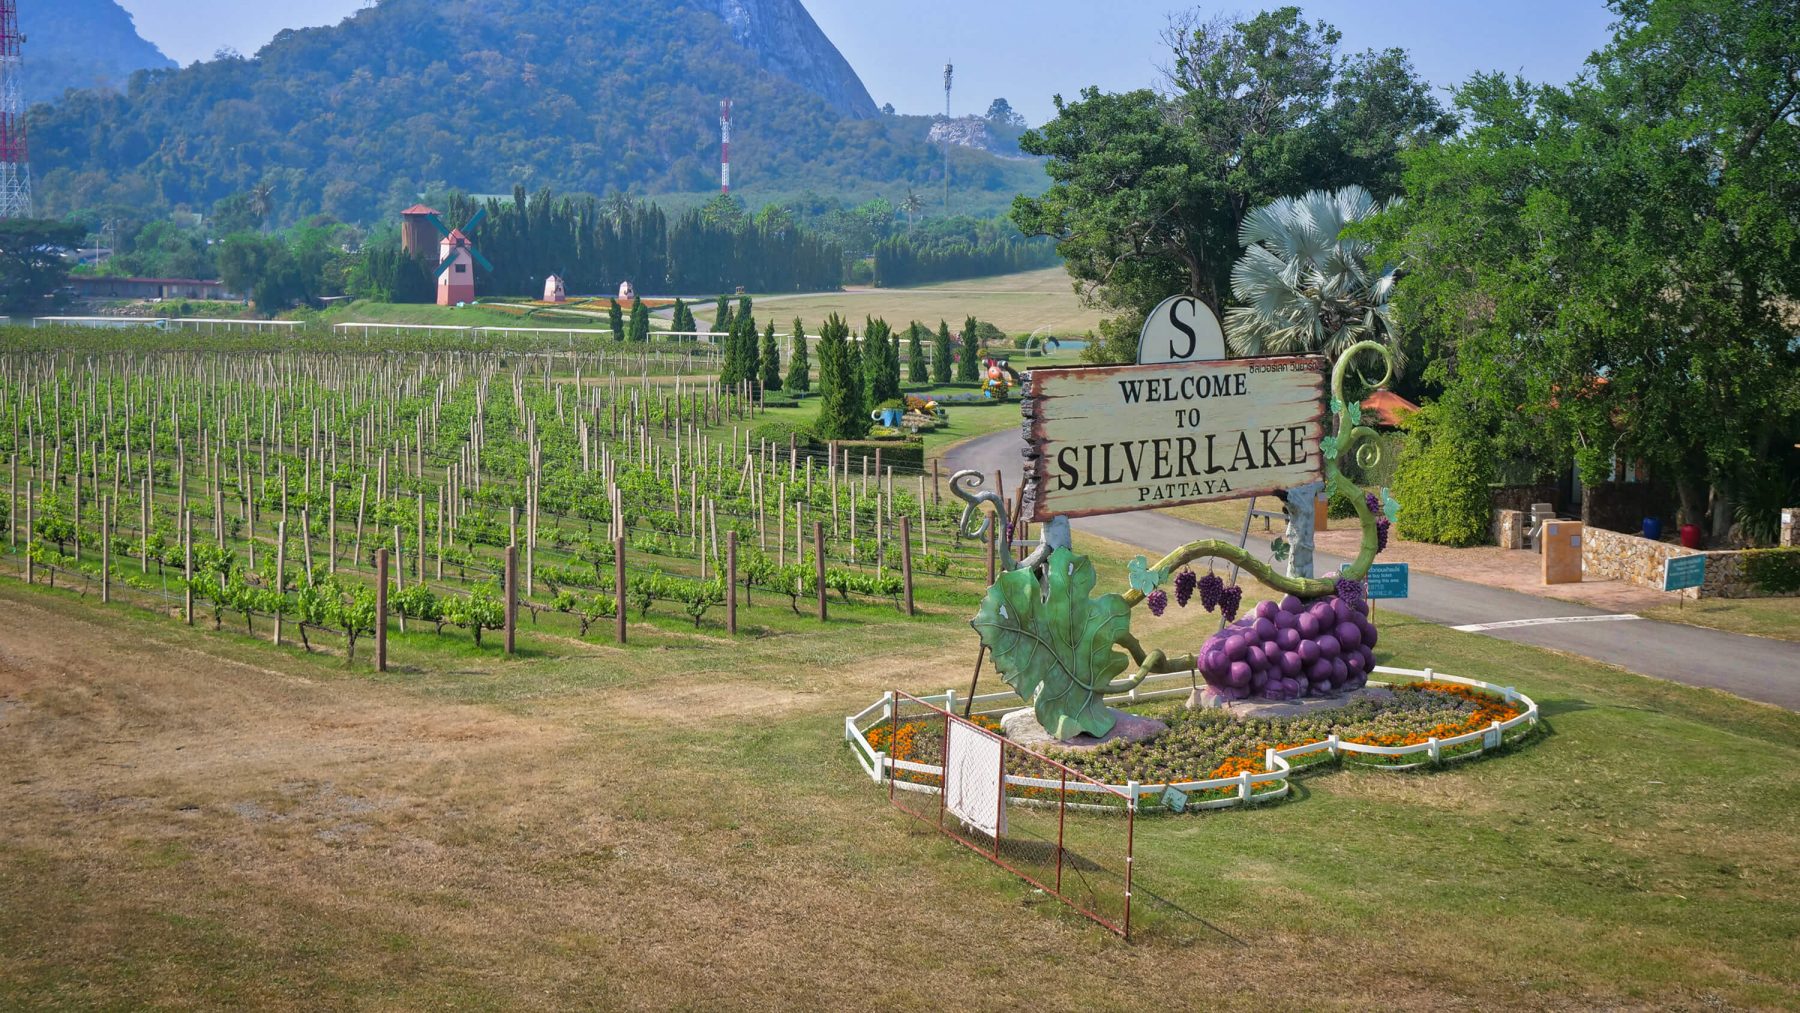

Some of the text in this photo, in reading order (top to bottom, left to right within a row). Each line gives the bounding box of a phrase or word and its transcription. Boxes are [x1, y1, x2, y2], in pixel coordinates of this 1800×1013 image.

[1169, 297, 1196, 360] S
[1118, 372, 1248, 404] WELCOME
[1175, 407, 1201, 429] TO
[1057, 425, 1308, 491] SILVERLAKE
[1138, 477, 1232, 501] PATTAYA
